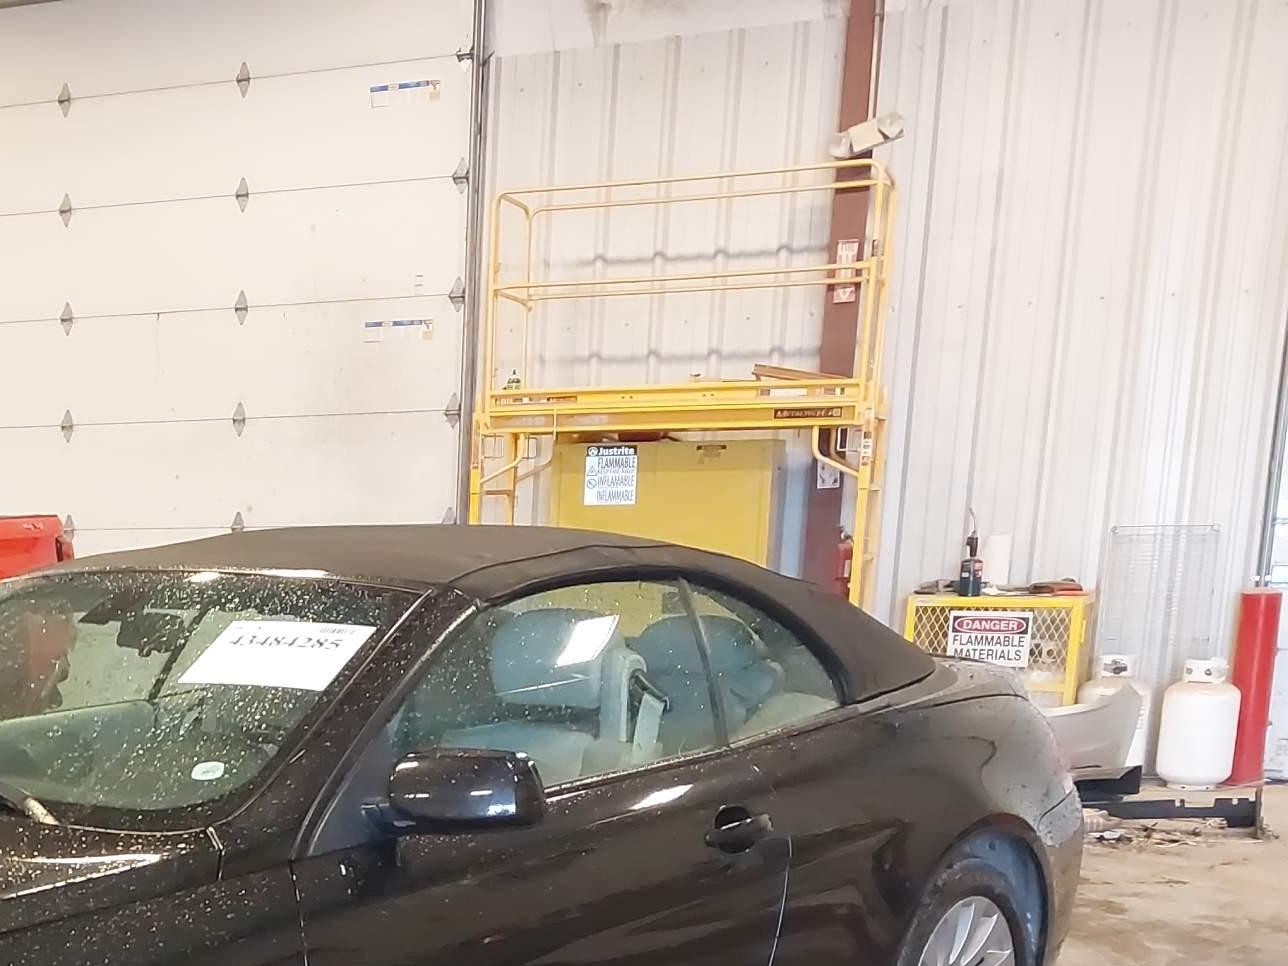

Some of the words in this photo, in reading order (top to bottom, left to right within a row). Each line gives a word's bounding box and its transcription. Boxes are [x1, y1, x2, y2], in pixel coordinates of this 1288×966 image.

[598, 446, 635, 456] Justrite
[598, 457, 636, 468] FLAMMABLE
[963, 619, 1018, 631] DANGER
[229, 635, 344, 650] 43484285
[953, 634, 1026, 648] FLAMMABLE
[953, 648, 1022, 661] MATERIALS
